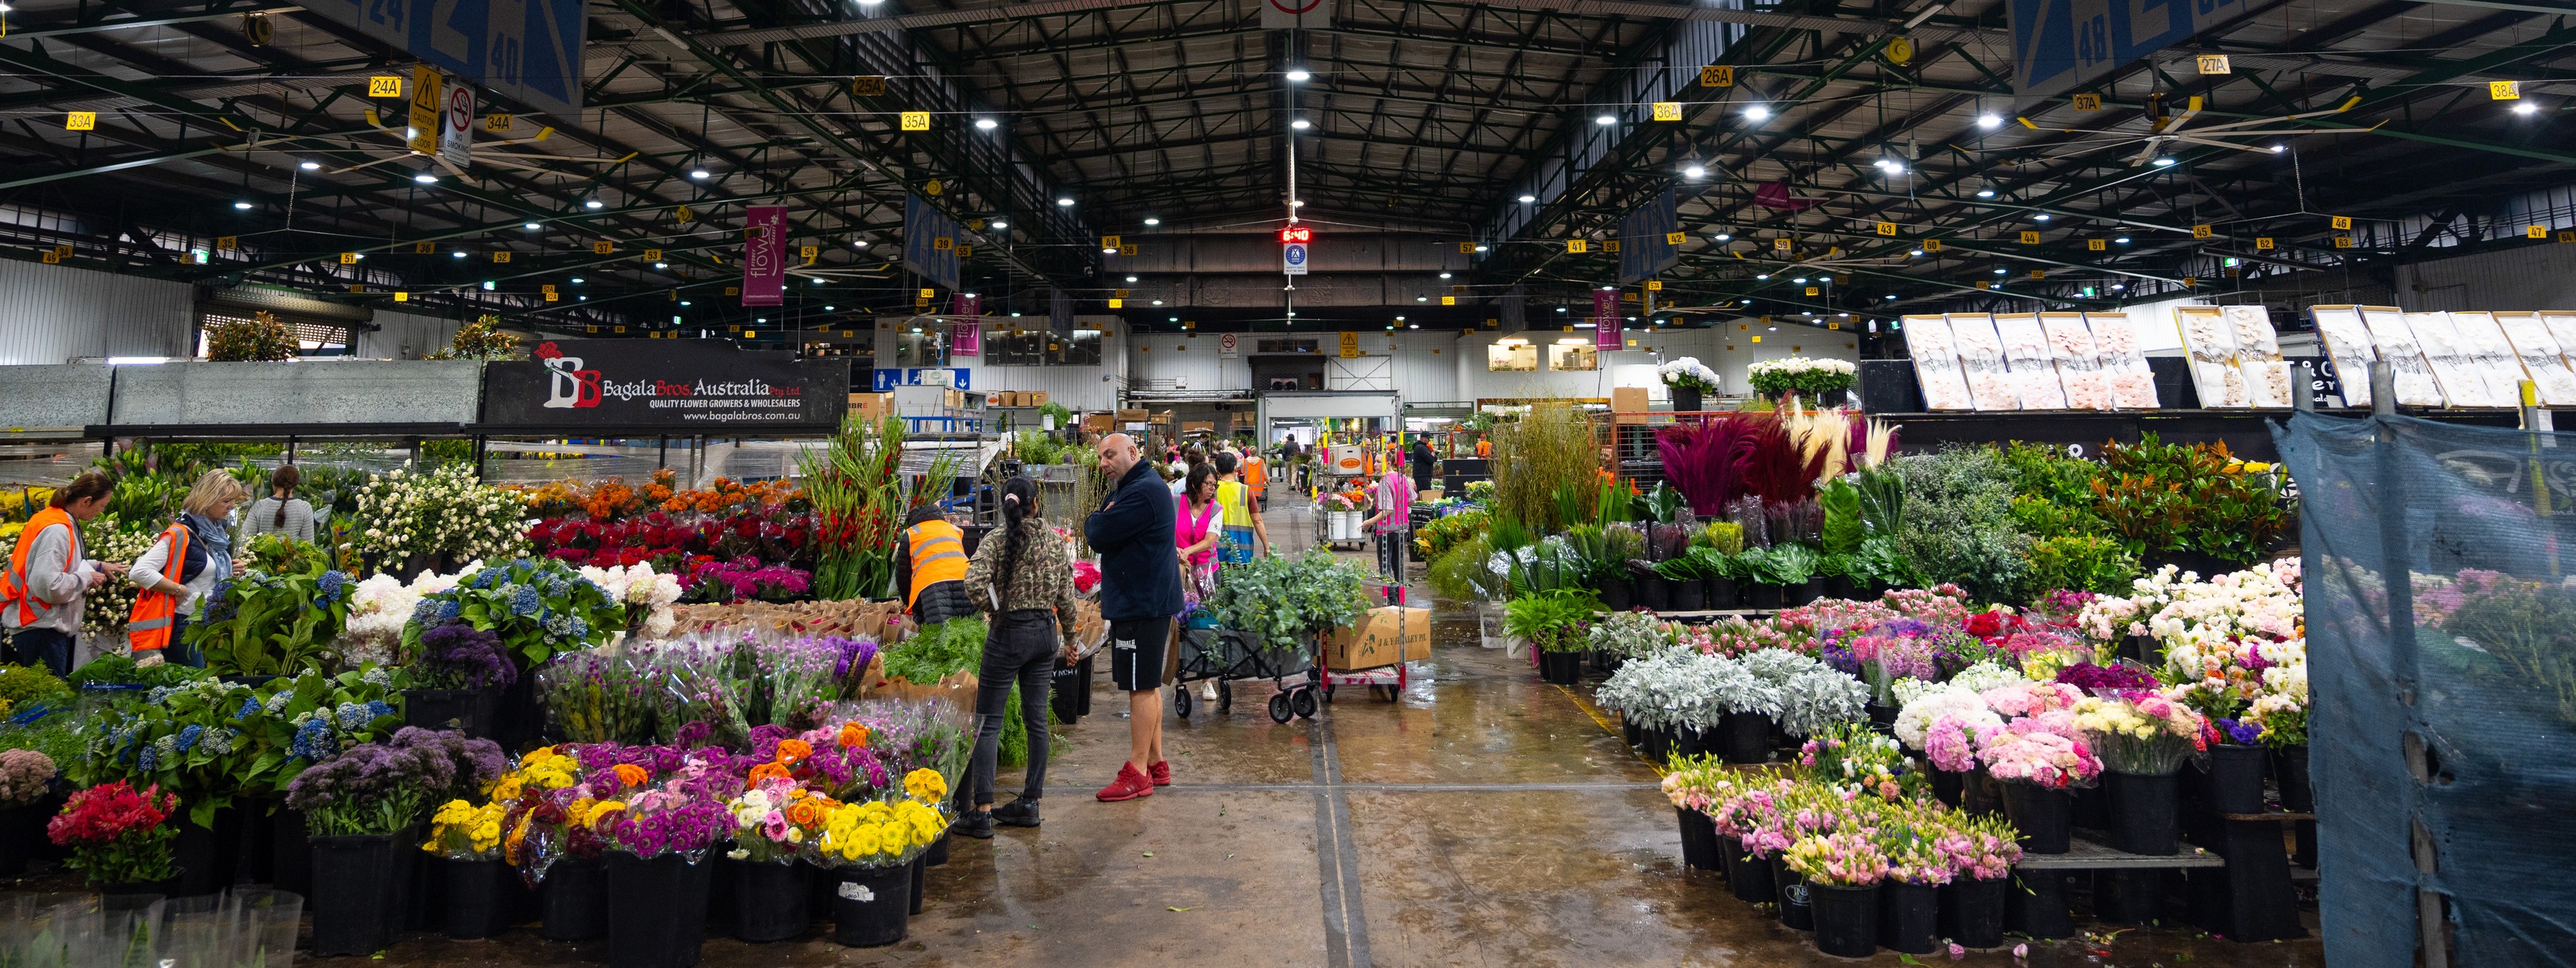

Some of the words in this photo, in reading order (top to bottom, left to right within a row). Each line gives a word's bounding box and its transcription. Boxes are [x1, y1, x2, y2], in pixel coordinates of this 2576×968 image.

[2079, 13, 2106, 69] 48
[491, 32, 518, 86] 40
[2201, 58, 2225, 71] 27A
[1705, 69, 1729, 83] 26A
[372, 79, 397, 94] 24A
[857, 79, 881, 93] 25A
[2494, 84, 2517, 97] 38A
[2077, 96, 2097, 109] 37A
[1657, 105, 1679, 118] 36A
[70, 114, 90, 127] 33A
[413, 112, 436, 126] CAUTION
[488, 116, 509, 129] 34A
[904, 114, 926, 127] 35A
[418, 126, 429, 137] WET
[455, 133, 463, 142] NO
[414, 139, 431, 150] FLOOR
[446, 140, 469, 153] SMOKING
[2335, 219, 2346, 228] 46
[1881, 224, 1891, 234] 43
[2197, 228, 2207, 236] 45
[2531, 228, 2541, 237] 47
[1283, 230, 1308, 241] 6:40
[1672, 234, 1682, 243] 42
[2025, 234, 2035, 242] 44
[2561, 233, 2572, 241] 64
[222, 239, 233, 248] 35
[938, 240, 948, 248] 39
[1106, 238, 1116, 247] 40
[1572, 242, 1581, 251] 41
[1777, 240, 1787, 248] 59
[2093, 241, 2101, 249] 61
[2260, 239, 2270, 248] 62
[2339, 238, 2349, 247] 63
[419, 245, 431, 253] 36
[598, 244, 608, 252] 37
[750, 219, 769, 278] flower
[648, 251, 658, 259] 53
[694, 378, 770, 396] Australia
[770, 387, 785, 397] Pty.
[786, 387, 801, 396] Ltd.
[649, 400, 679, 409] QUALITY
[681, 400, 708, 408] FLOWER
[709, 400, 742, 408] GROWERS
[744, 400, 749, 408] &
[751, 400, 800, 408] WHOLESALERS
[683, 411, 800, 423] www.bagalabros.com.au
[1378, 639, 1382, 647] J
[1383, 637, 1388, 646] &
[1395, 633, 1419, 645] HALEY
[1052, 669, 1073, 677] YNCH
